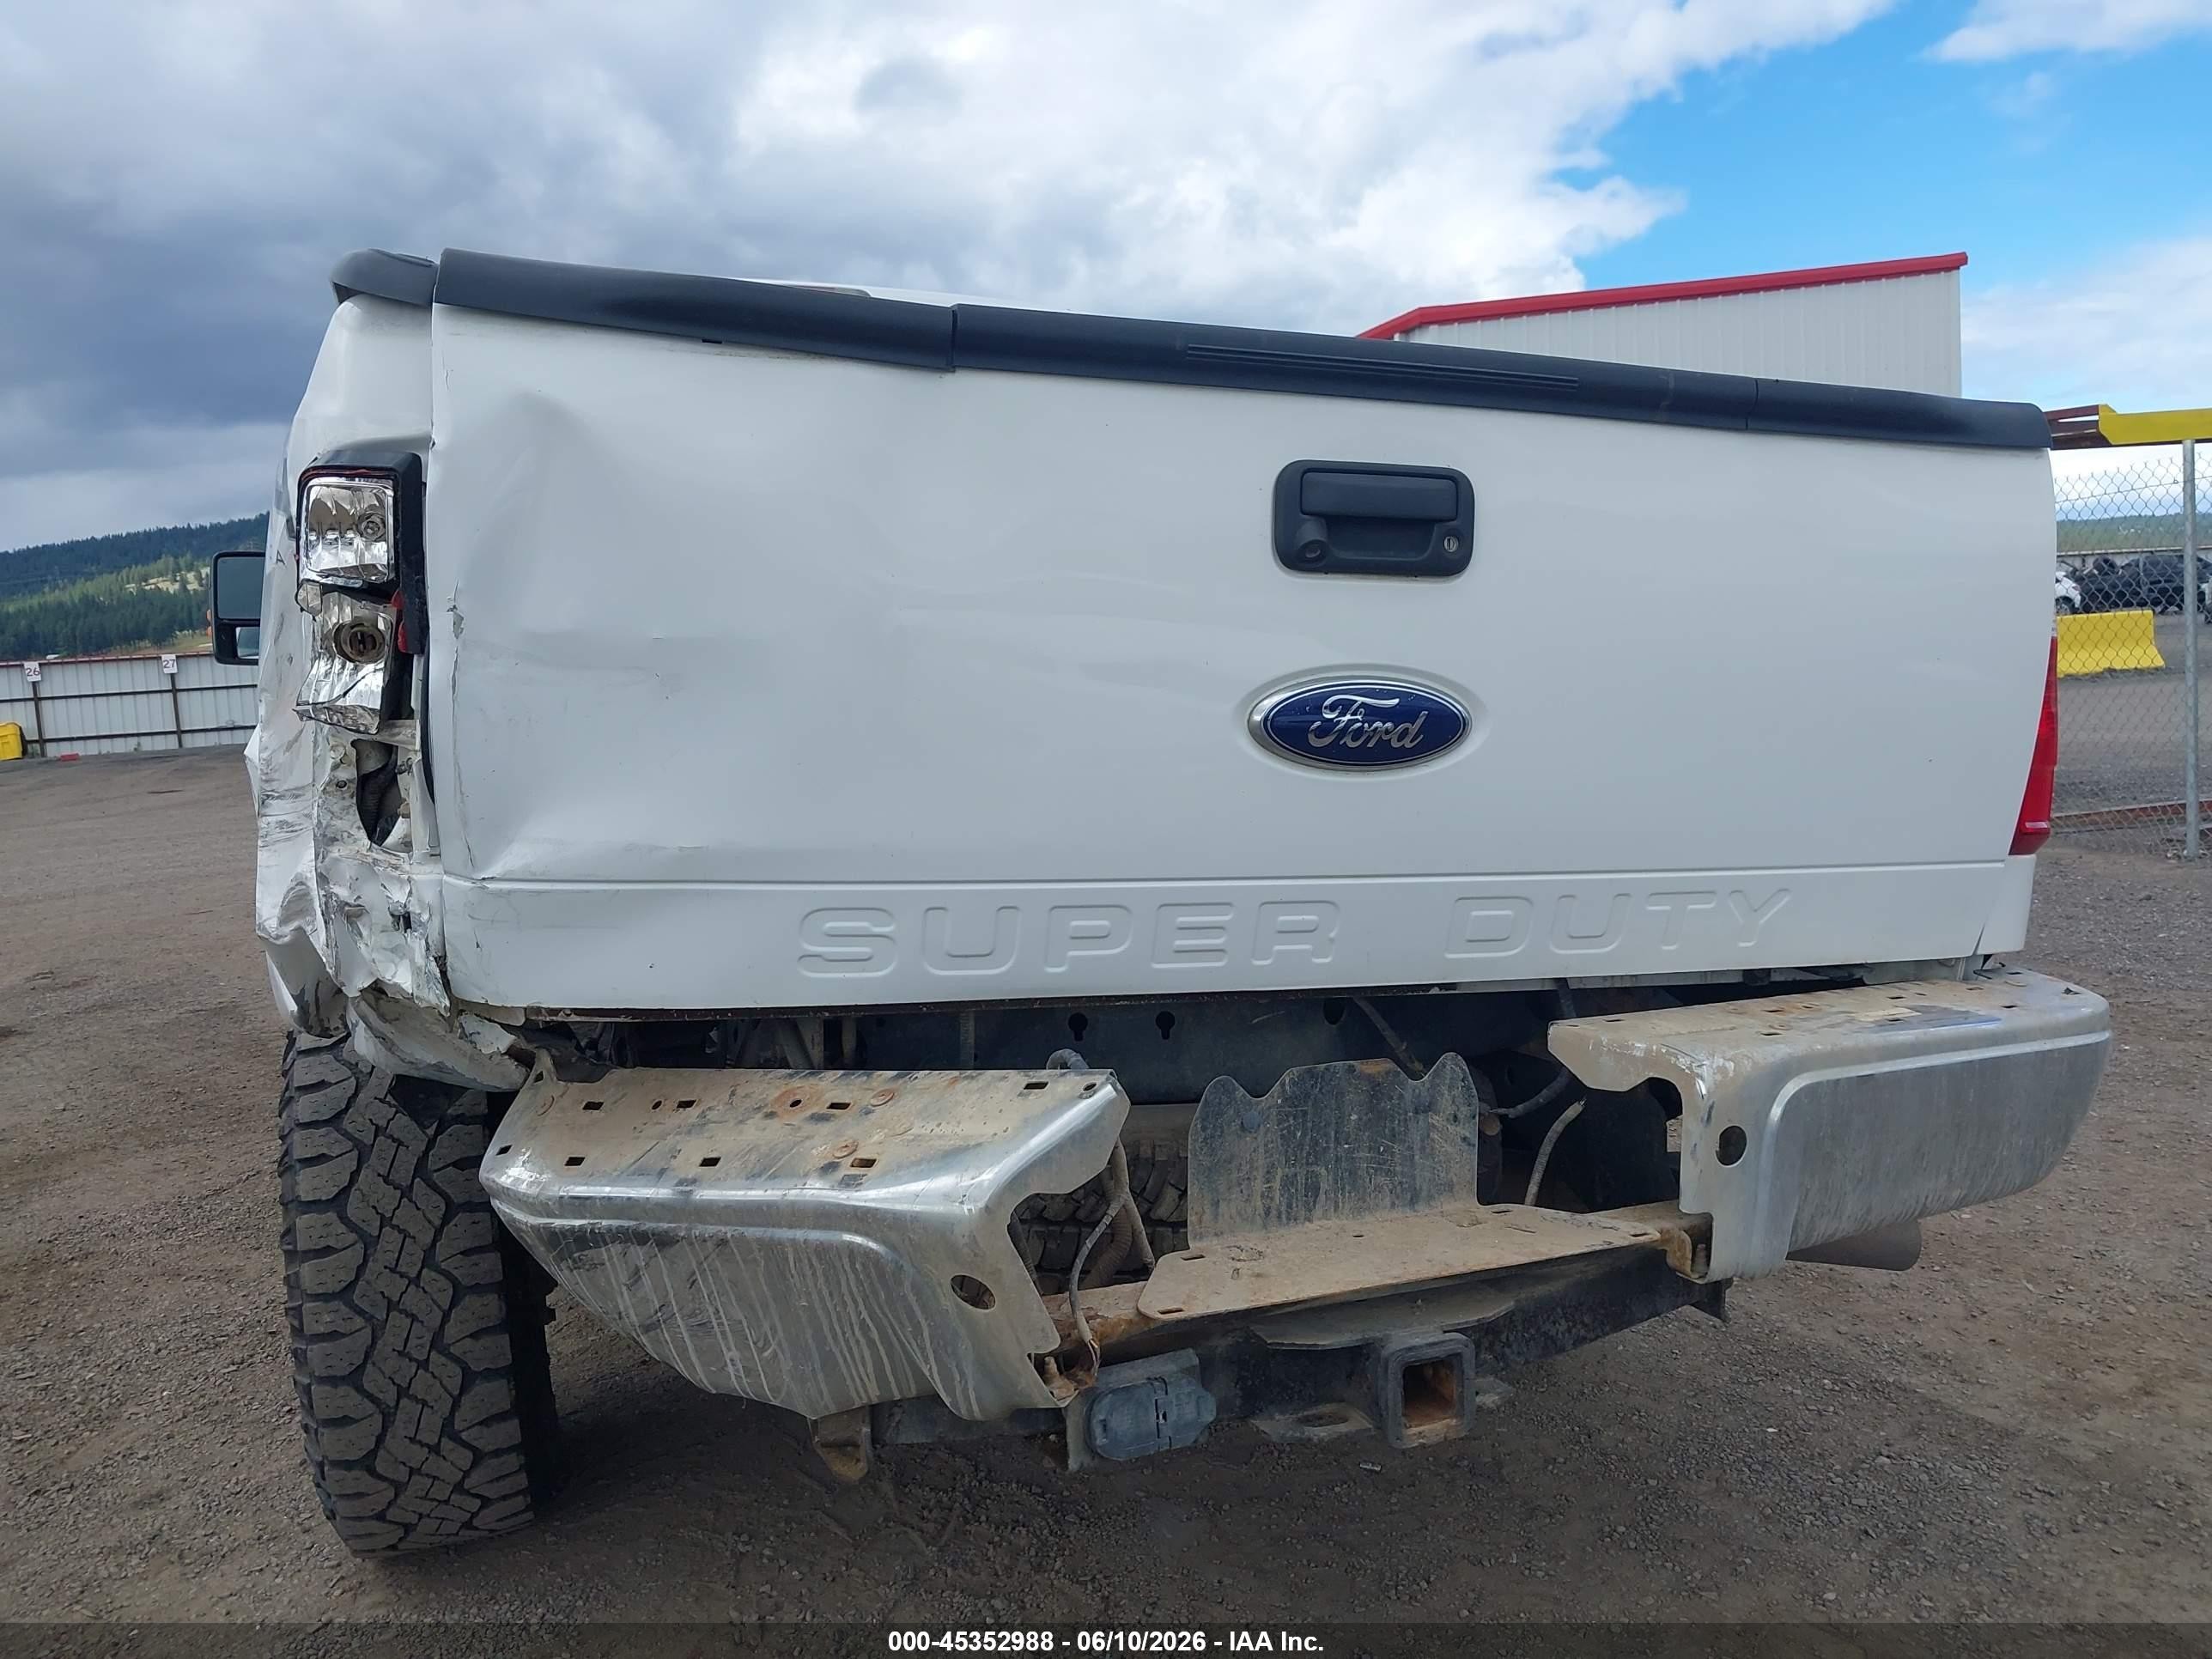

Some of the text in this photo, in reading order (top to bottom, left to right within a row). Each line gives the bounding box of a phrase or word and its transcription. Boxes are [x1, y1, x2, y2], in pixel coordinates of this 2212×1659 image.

[26, 666, 40, 677] 26
[163, 659, 176, 669] 27
[1307, 694, 1429, 749] Ford
[797, 888, 1792, 978] SUPER DUTY
